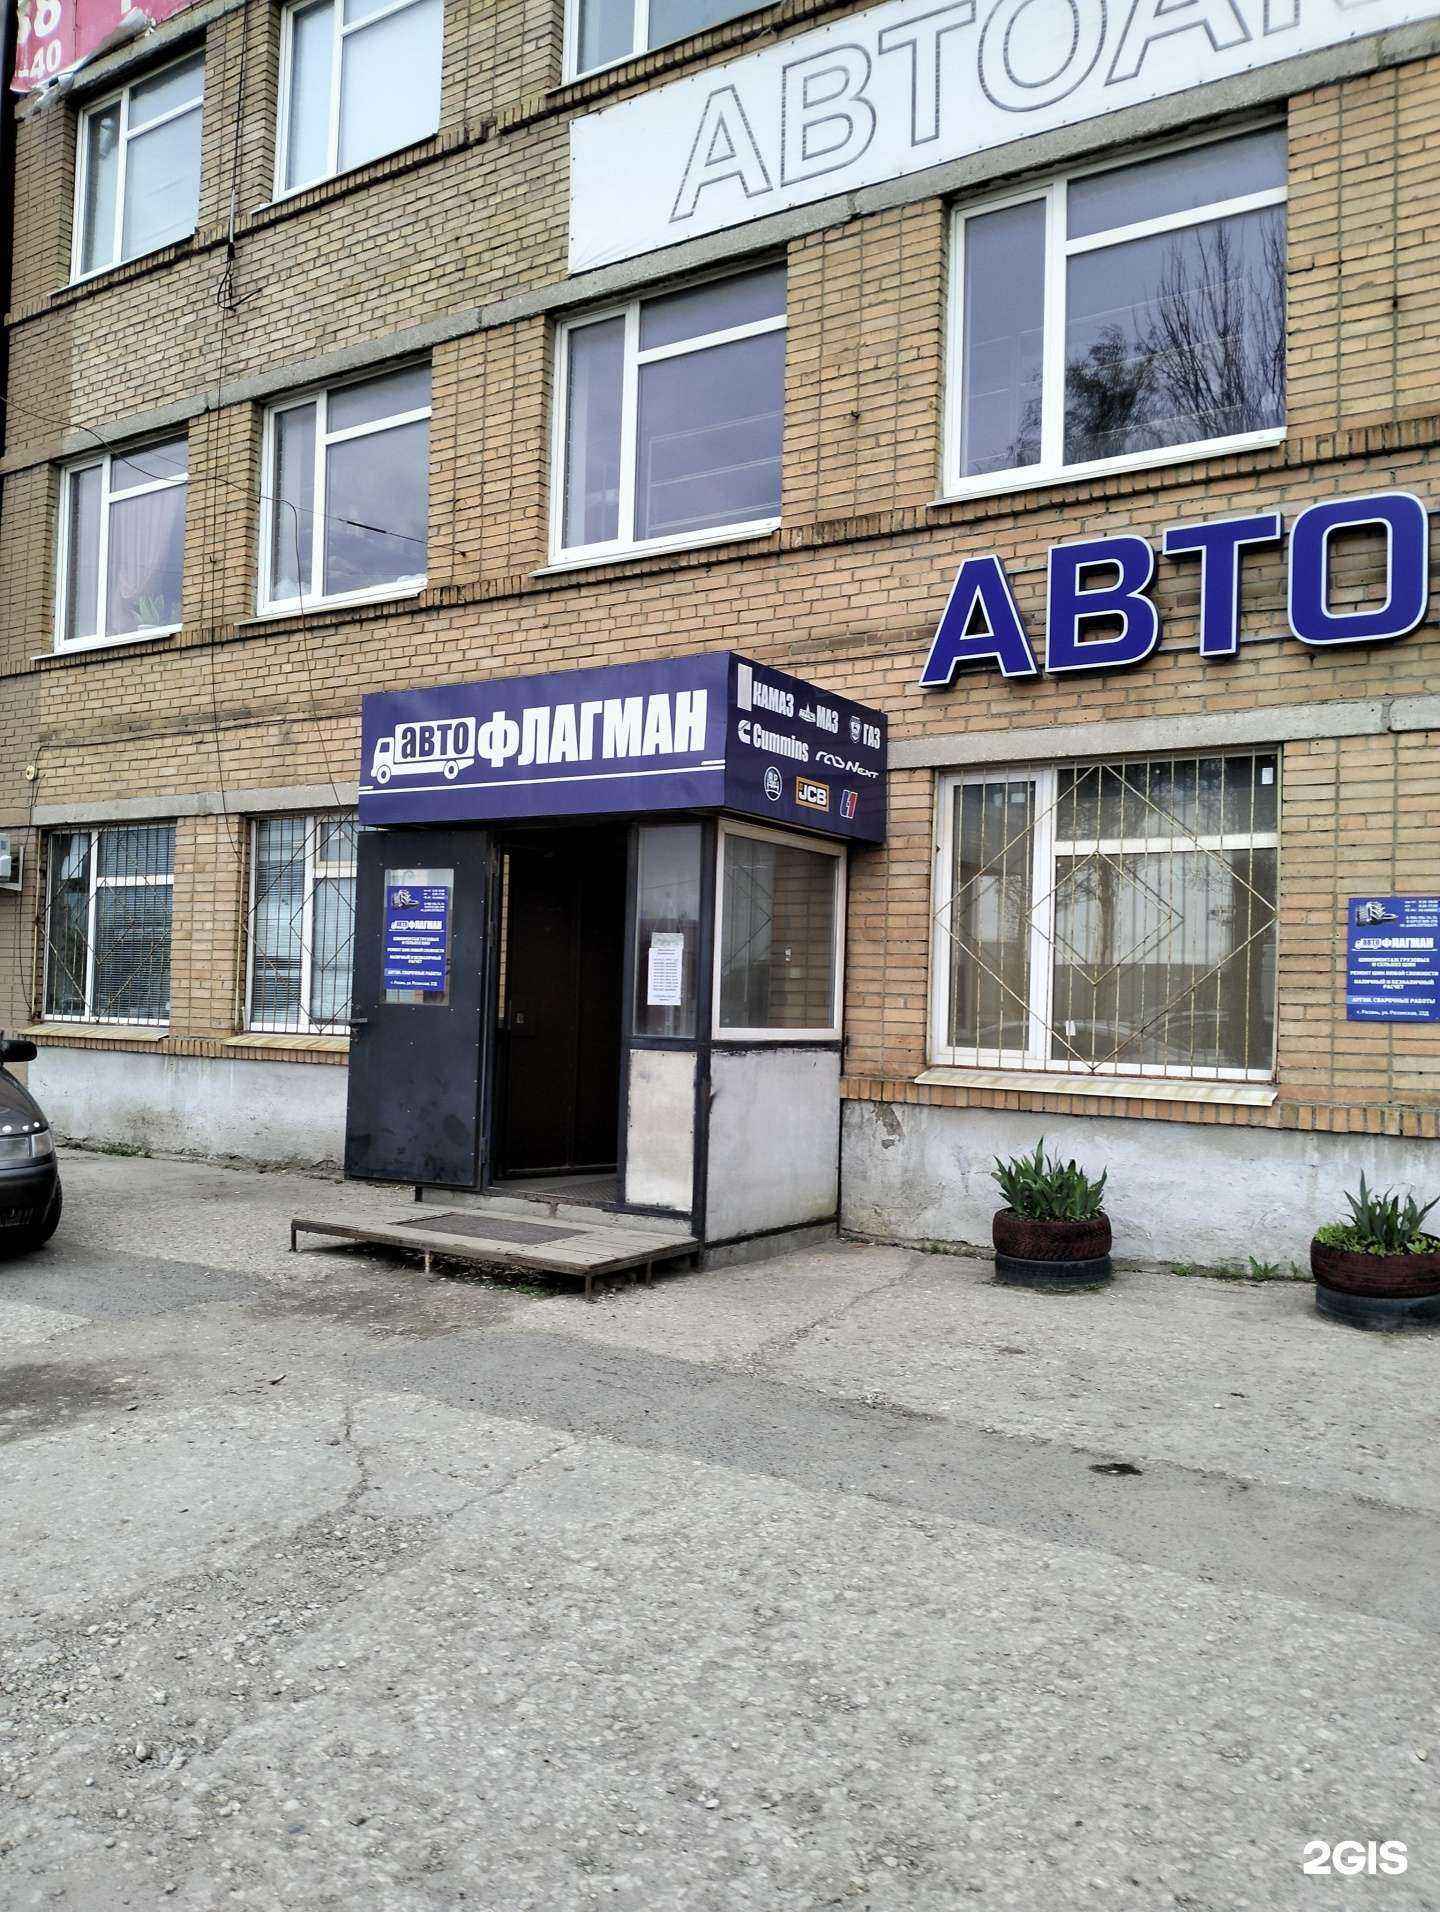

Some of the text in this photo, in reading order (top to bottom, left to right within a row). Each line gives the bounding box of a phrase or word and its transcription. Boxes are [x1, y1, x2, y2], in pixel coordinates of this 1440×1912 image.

[669, 0, 1385, 224] АВТОА
[918, 491, 1430, 689] АВТО
[752, 723, 810, 763] Cummins
[816, 704, 839, 734] МАЗ
[862, 723, 881, 750] ГАЗ
[798, 784, 827, 806] JCB
